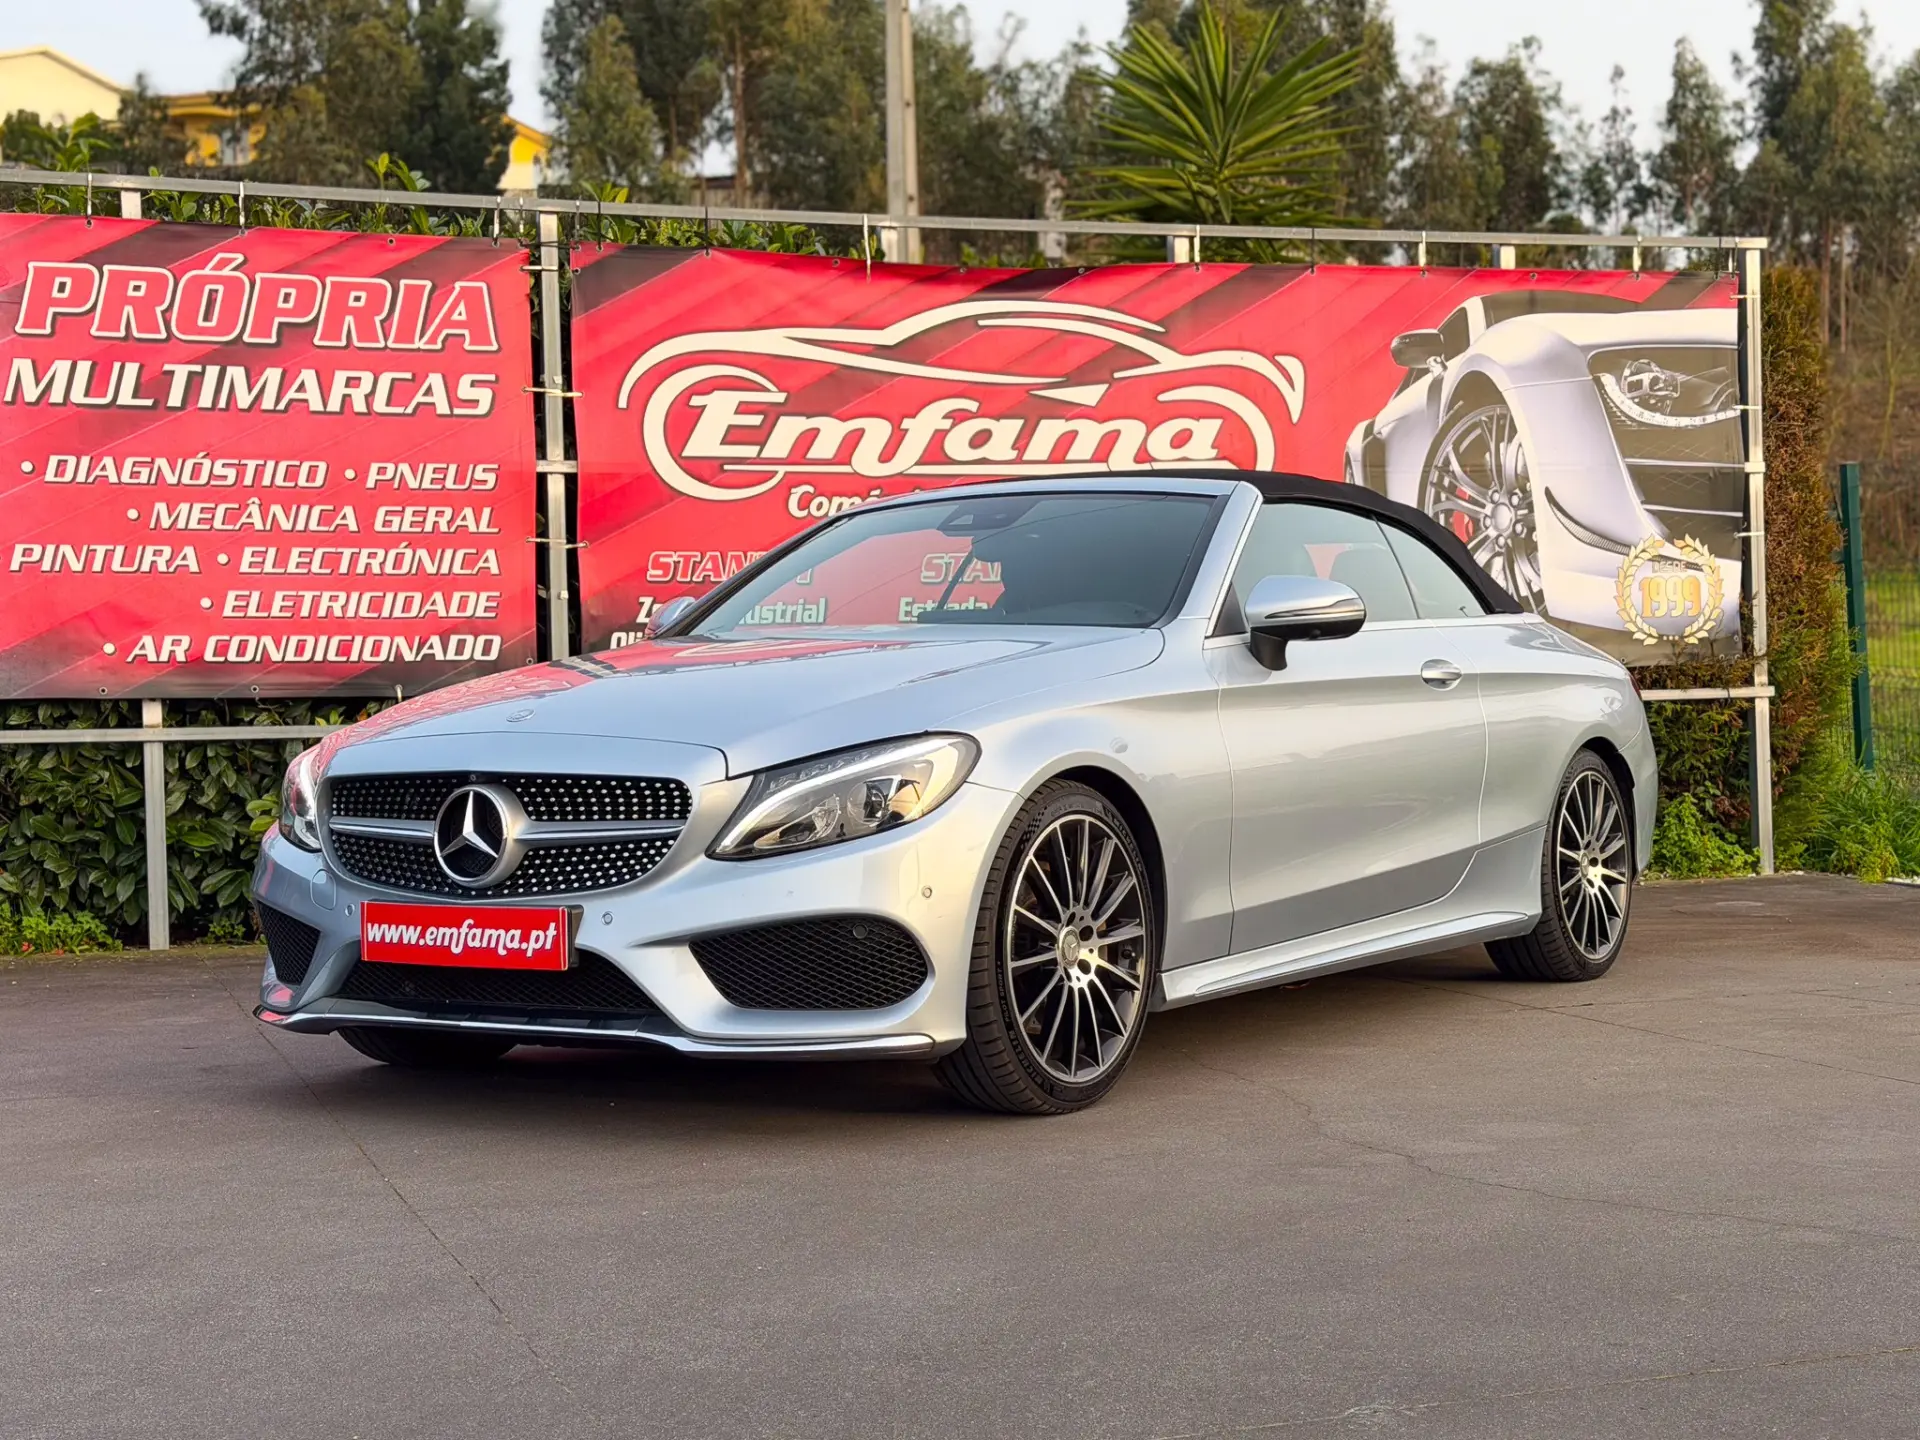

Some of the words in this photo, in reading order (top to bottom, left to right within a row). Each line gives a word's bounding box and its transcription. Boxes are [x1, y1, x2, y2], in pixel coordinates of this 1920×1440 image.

[14, 252, 500, 352] PRÓPRIA
[3, 357, 497, 415] MULTIMARCAS
[681, 390, 1224, 478] Emfama
[44, 451, 328, 488] DIAGNÓSTICO
[365, 462, 499, 491] PNEUS
[149, 497, 360, 532] MECÂNICA
[373, 506, 500, 533] GERAL
[9, 543, 201, 573] PINTURA
[239, 541, 500, 575] ELECTRÓNICA
[646, 551, 769, 582] STAN
[222, 590, 500, 619] ELETRICIDADE
[738, 597, 826, 625] ustrial
[1639, 575, 1701, 618] 1999
[126, 635, 192, 662] AR
[203, 634, 502, 662] CONDICIONADO
[366, 919, 558, 957] www.emfama.pt
